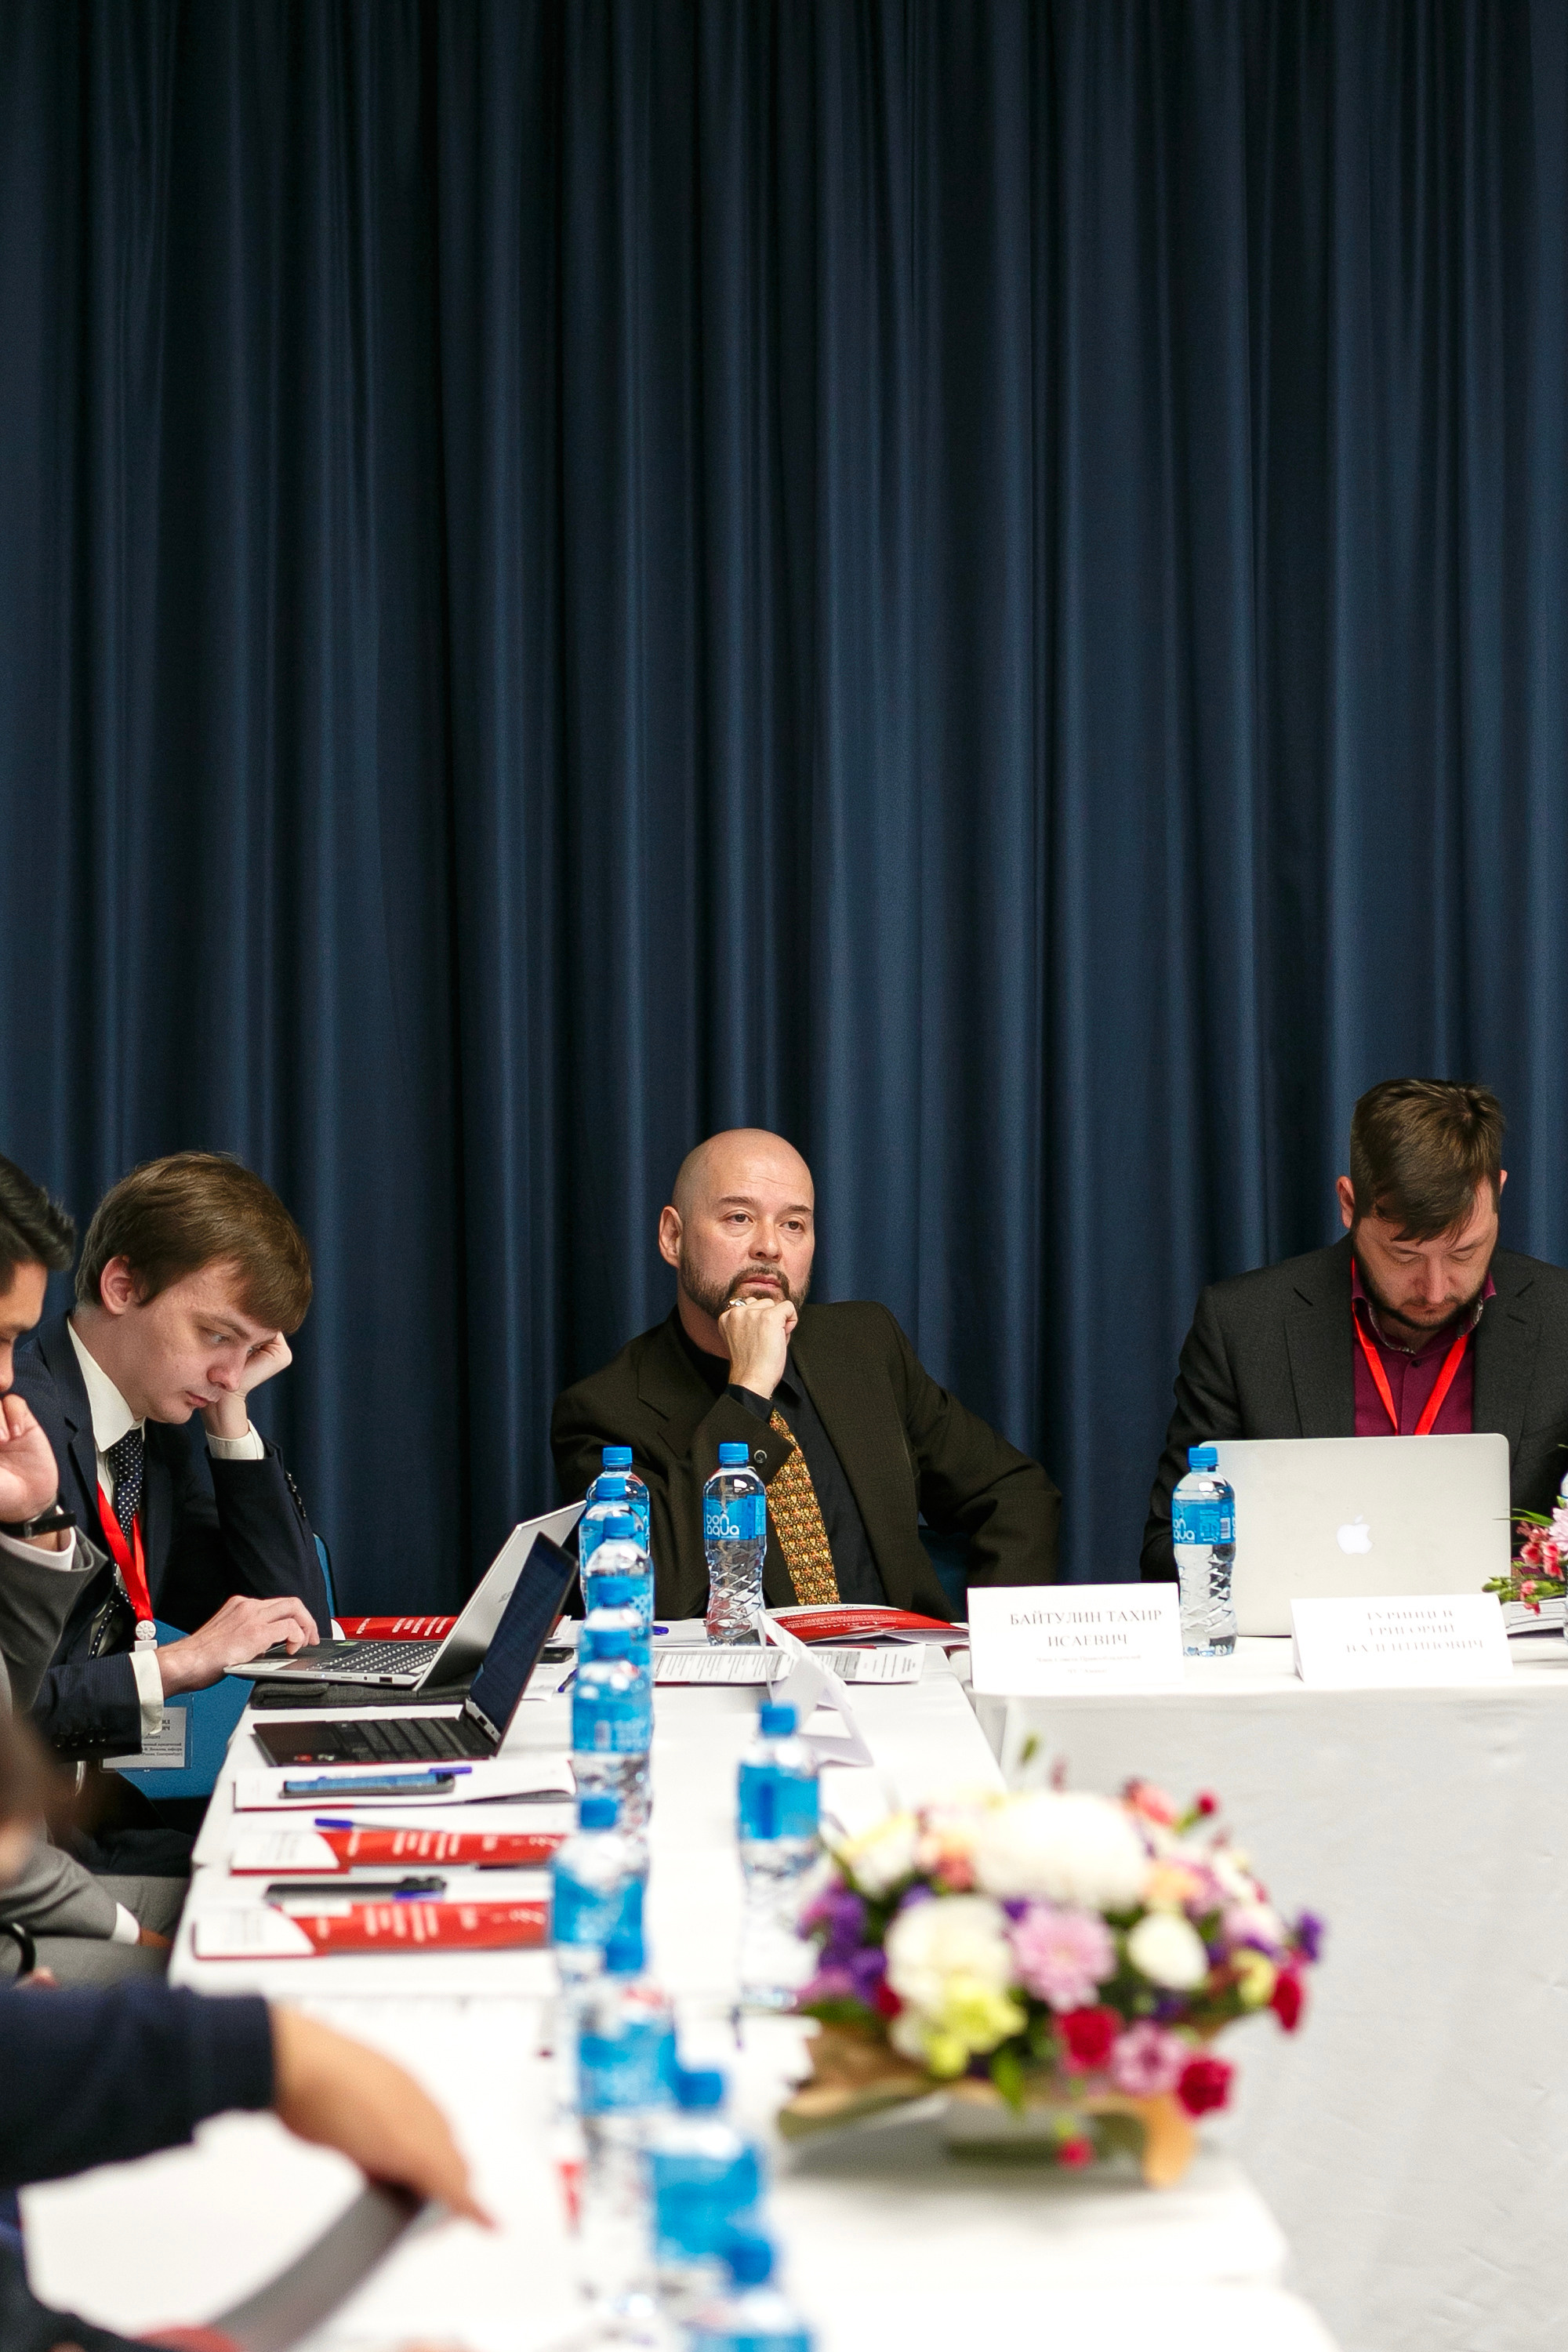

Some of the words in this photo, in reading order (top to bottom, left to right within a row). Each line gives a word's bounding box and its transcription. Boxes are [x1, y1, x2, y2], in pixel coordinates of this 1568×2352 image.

[706, 1525, 740, 1537] aqua
[1010, 1610, 1102, 1625] БАЙТУЛИН
[1106, 1610, 1162, 1622] ТАХИР
[1047, 1634, 1128, 1647] ИСАЕВИЧ
